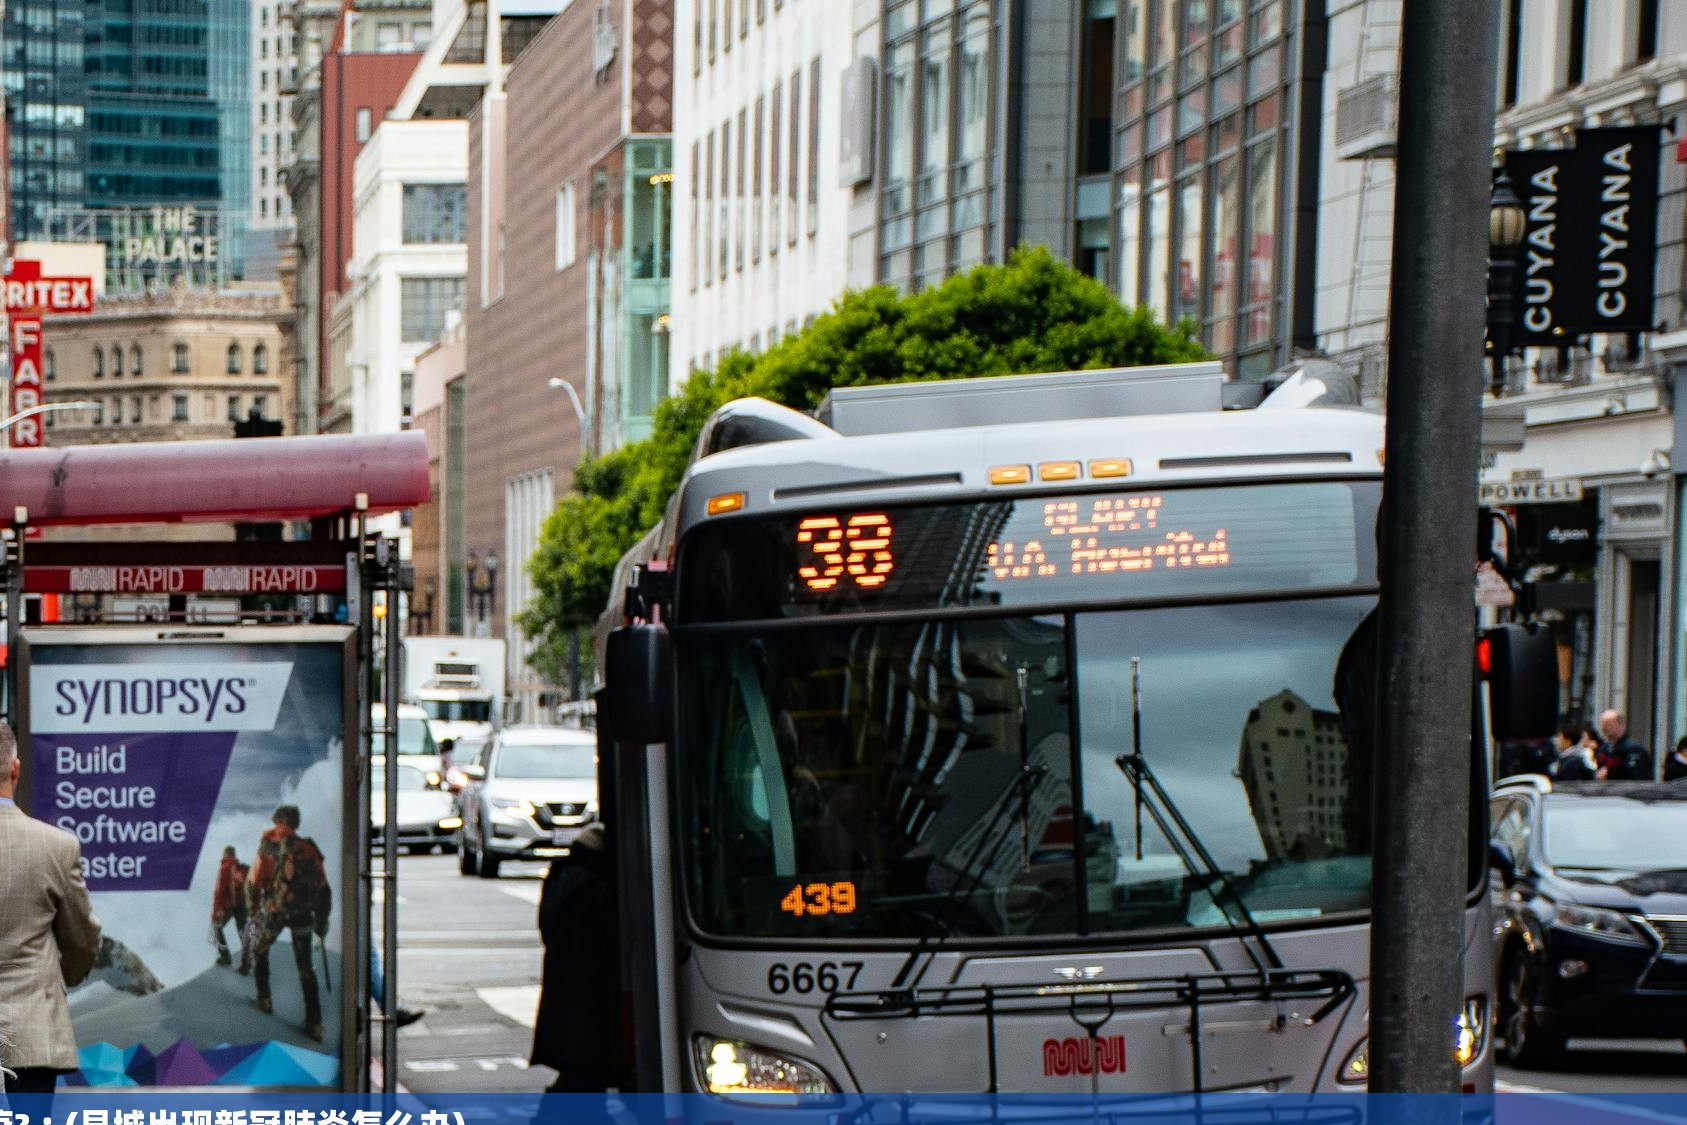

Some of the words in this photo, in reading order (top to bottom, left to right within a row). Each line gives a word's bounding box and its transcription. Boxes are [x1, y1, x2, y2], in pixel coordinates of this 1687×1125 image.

[152, 206, 194, 231] THE
[1597, 143, 1632, 317] CUYANA
[127, 237, 217, 263] PALACE
[1524, 165, 1559, 332] CUYANA
[14, 320, 41, 446] FABR
[1481, 482, 1577, 499] POWELL
[797, 512, 894, 590] 38
[119, 566, 184, 591] RAPID
[252, 566, 317, 591] RAPID
[56, 744, 126, 774] Build
[56, 781, 156, 809] Secure
[78, 852, 147, 878] aster
[781, 877, 856, 917] 439
[767, 961, 865, 994] 6667
